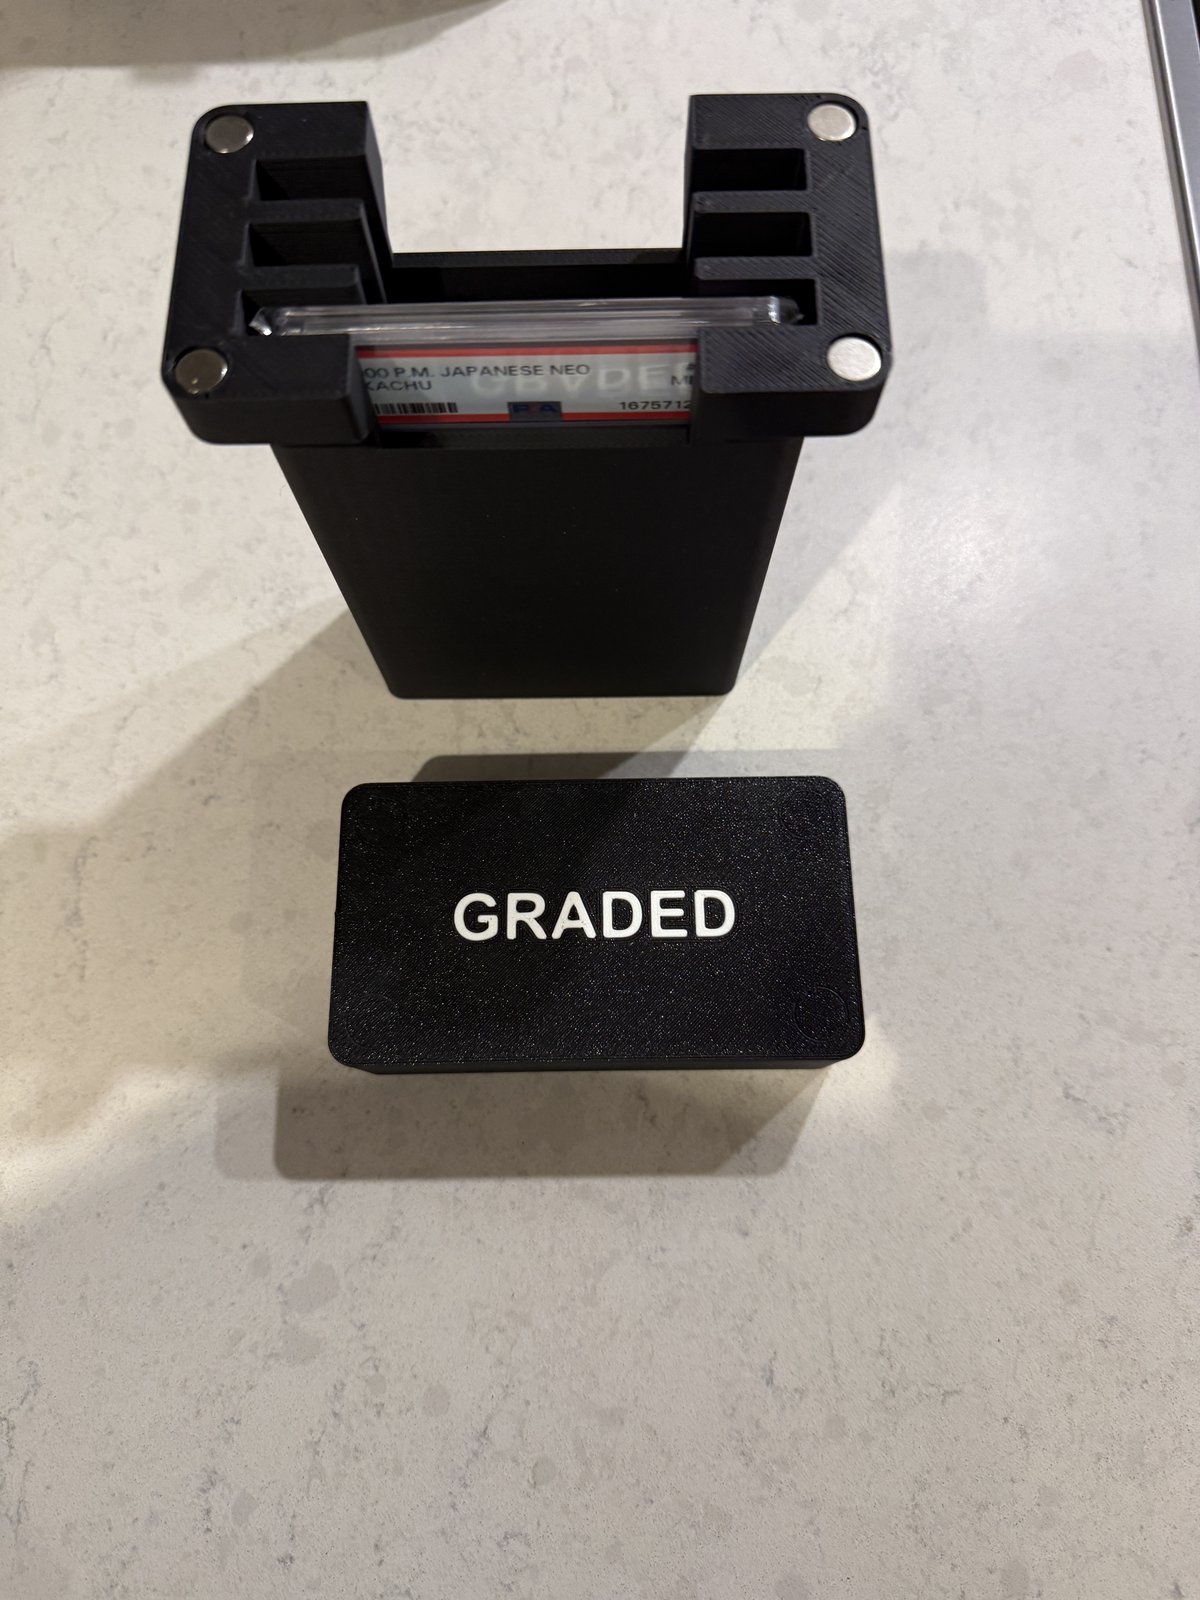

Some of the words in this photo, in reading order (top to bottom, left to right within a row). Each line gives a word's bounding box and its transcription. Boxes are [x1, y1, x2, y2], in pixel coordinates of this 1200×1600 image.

[440, 365, 544, 378] JAPANESE
[550, 363, 590, 376] NEO
[453, 889, 735, 941] GRADED
